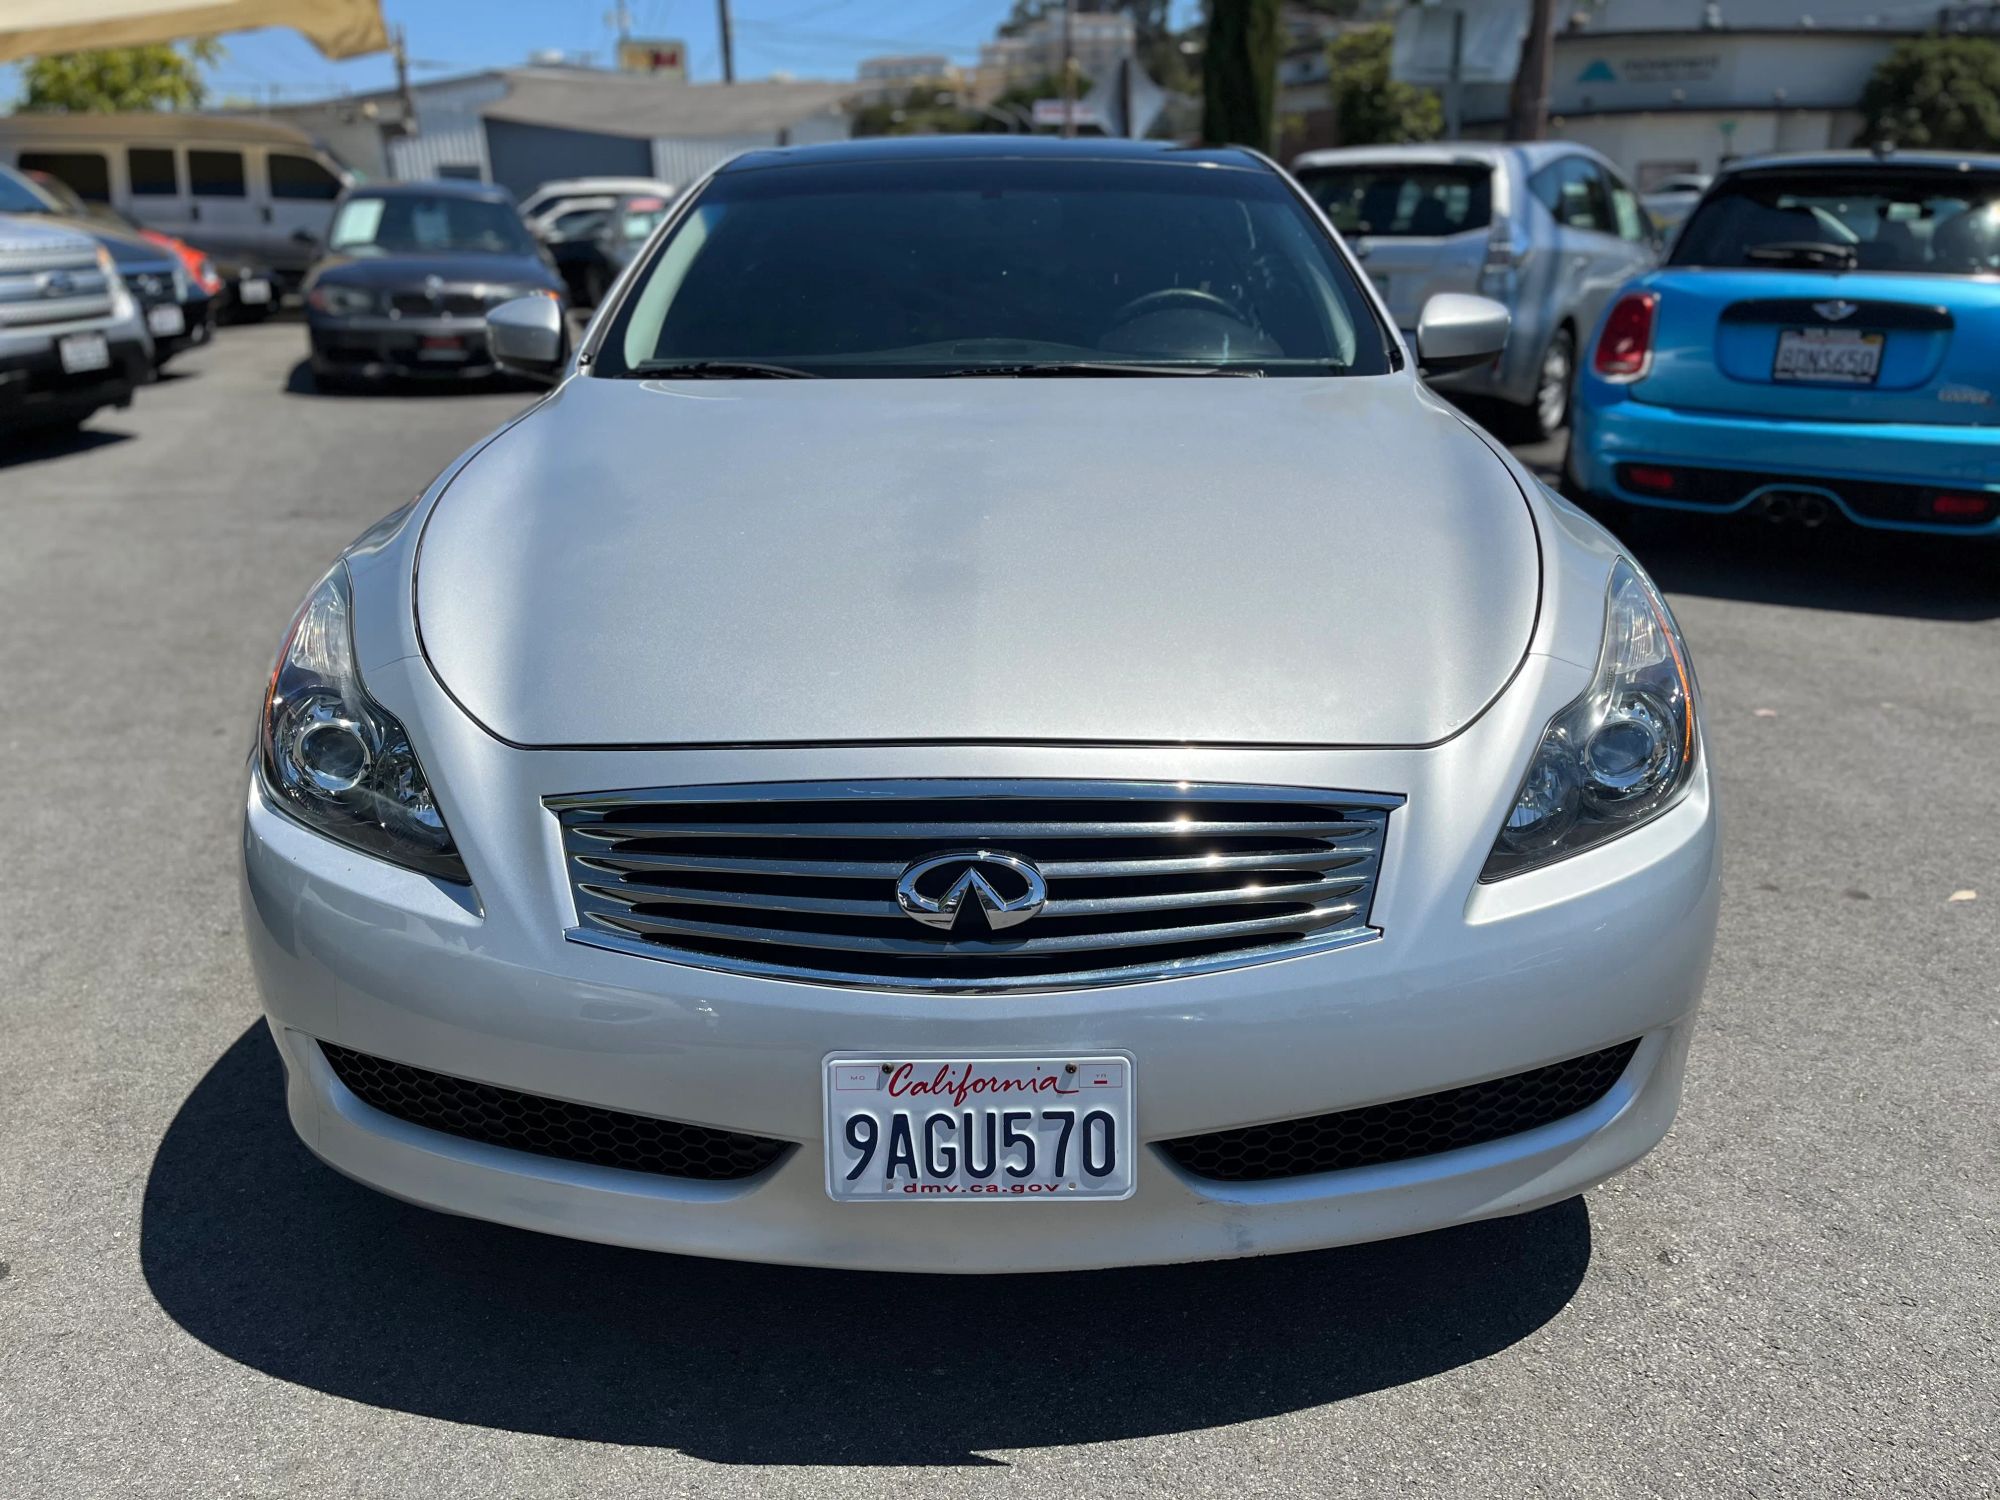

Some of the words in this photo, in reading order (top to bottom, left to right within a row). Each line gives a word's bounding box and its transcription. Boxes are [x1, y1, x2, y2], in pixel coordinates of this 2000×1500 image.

[888, 1063, 1079, 1107] California
[846, 1110, 1115, 1181] 9AGU570
[903, 1183, 1060, 1194] dmv.ca.gov
